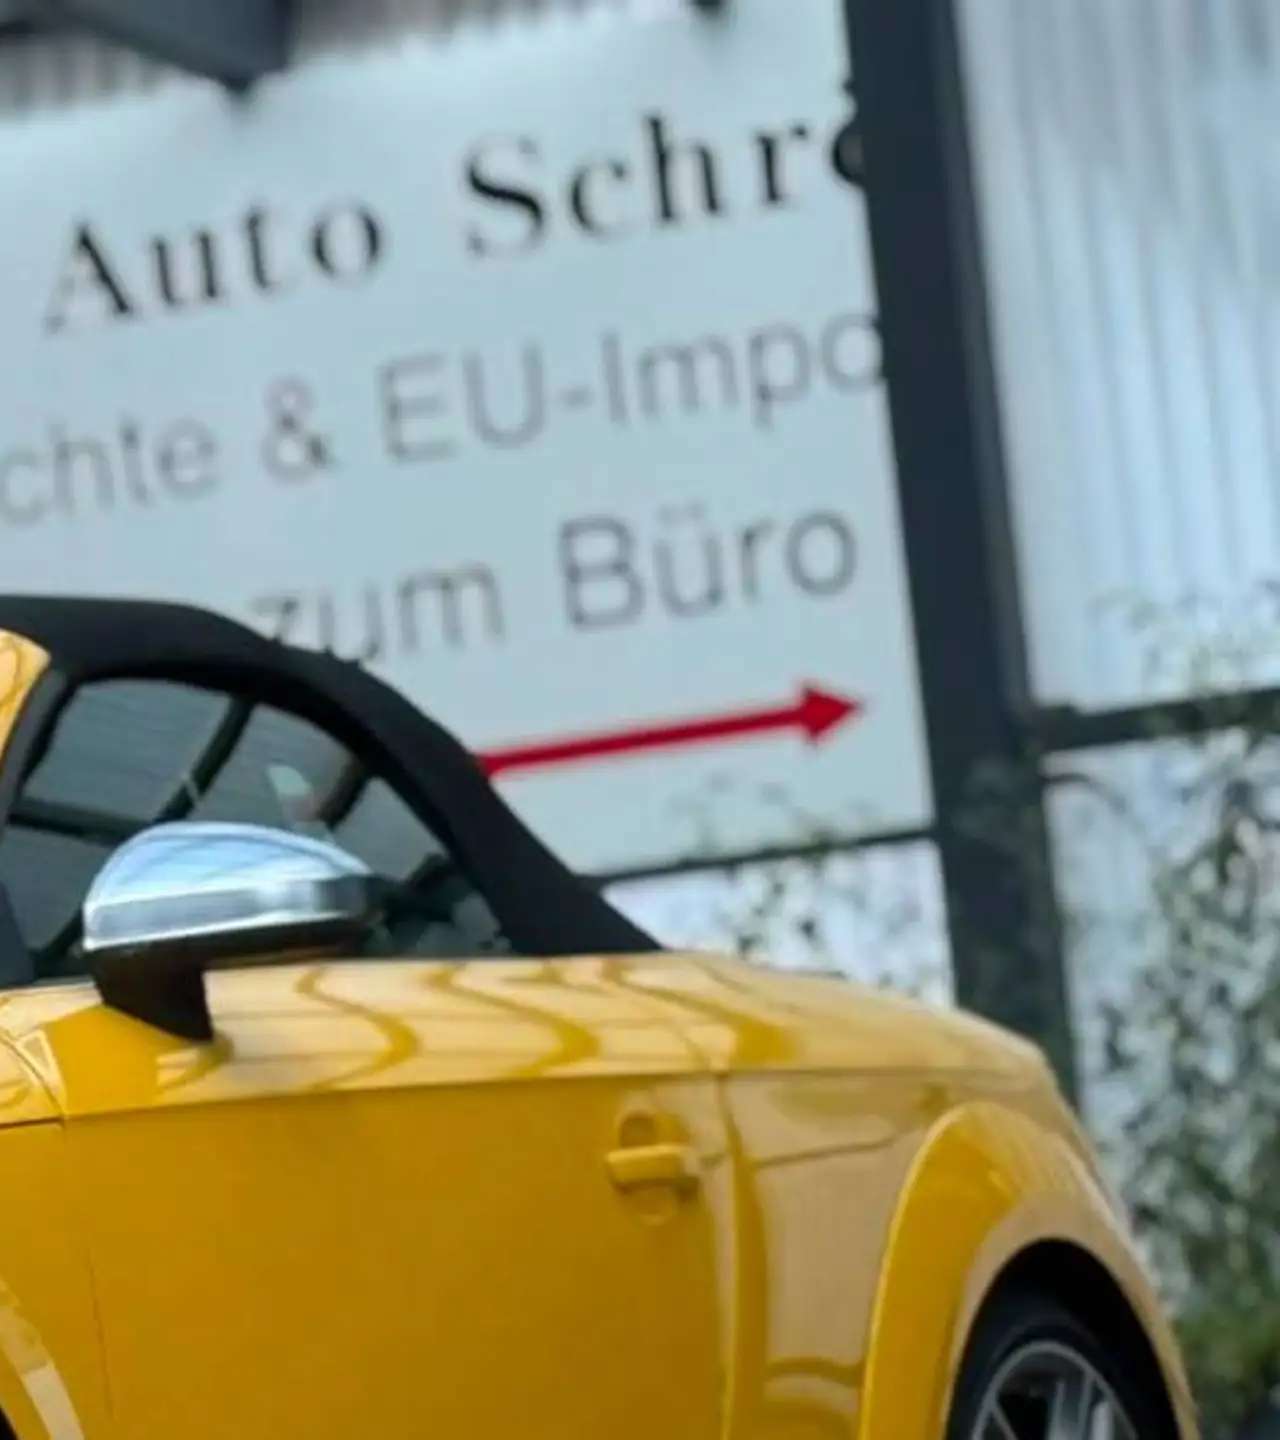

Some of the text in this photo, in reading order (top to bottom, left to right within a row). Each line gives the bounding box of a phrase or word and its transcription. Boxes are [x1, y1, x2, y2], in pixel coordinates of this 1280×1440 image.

[43, 195, 384, 334] Auto
[260, 376, 338, 484] &
[252, 502, 858, 662] zum Büro
